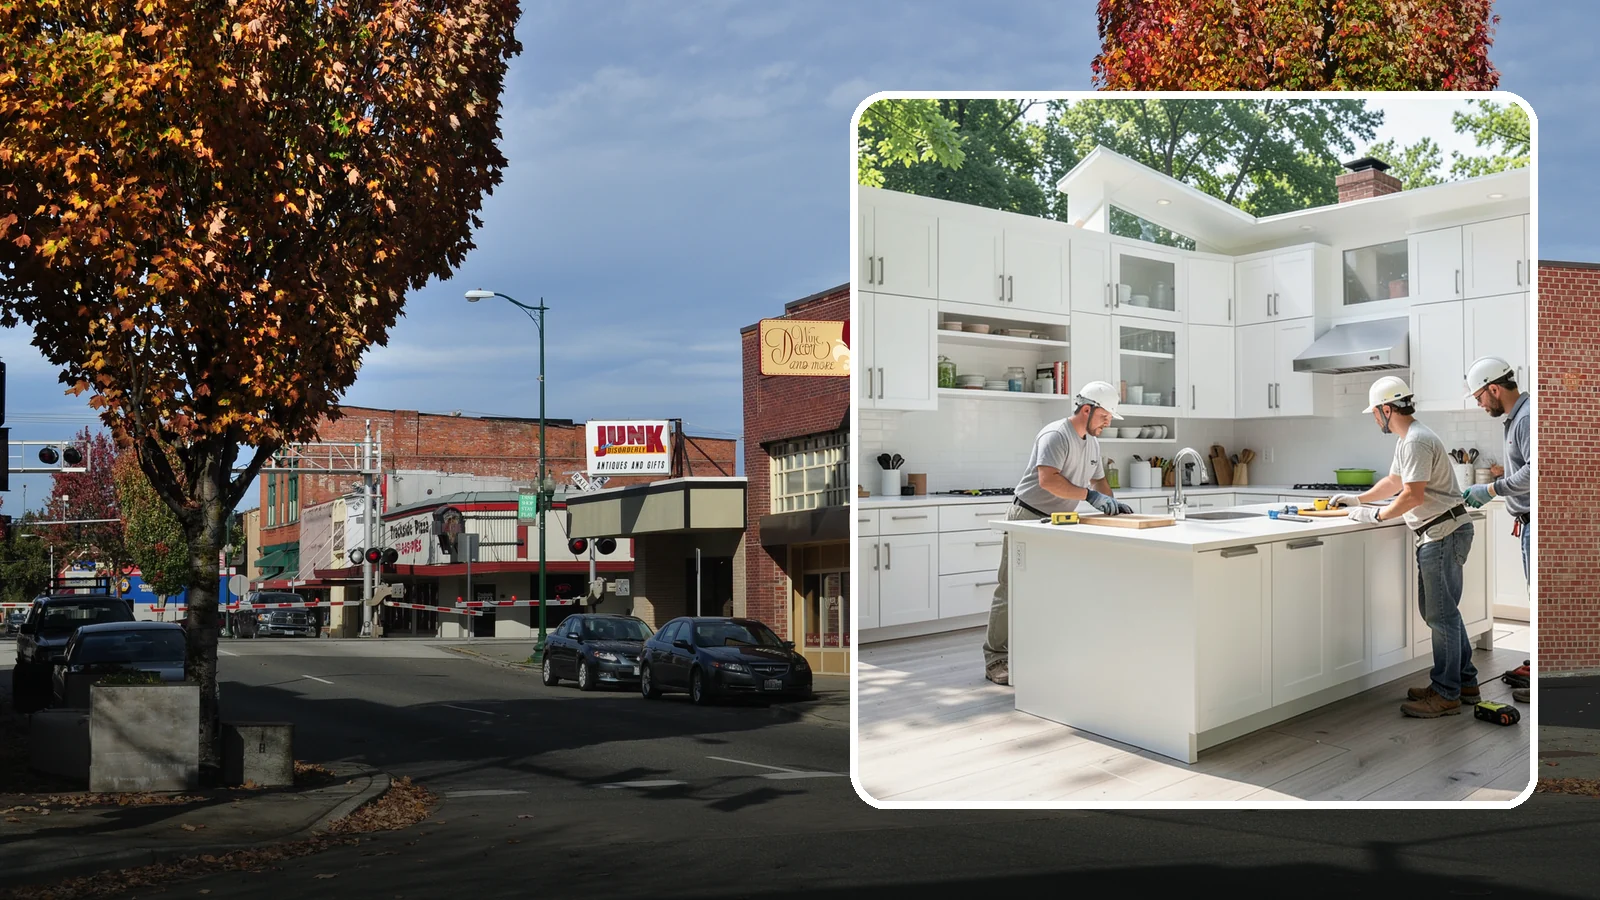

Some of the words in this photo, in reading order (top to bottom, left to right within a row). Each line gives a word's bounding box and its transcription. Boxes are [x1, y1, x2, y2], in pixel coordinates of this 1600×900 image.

[765, 327, 831, 365] Decor
[595, 425, 665, 457] JUNK
[607, 446, 646, 454] DISORDERLY
[597, 460, 628, 470] ANTIQUES
[631, 460, 644, 470] AND
[646, 460, 665, 470] GIFTS
[573, 473, 589, 492] RAIL
